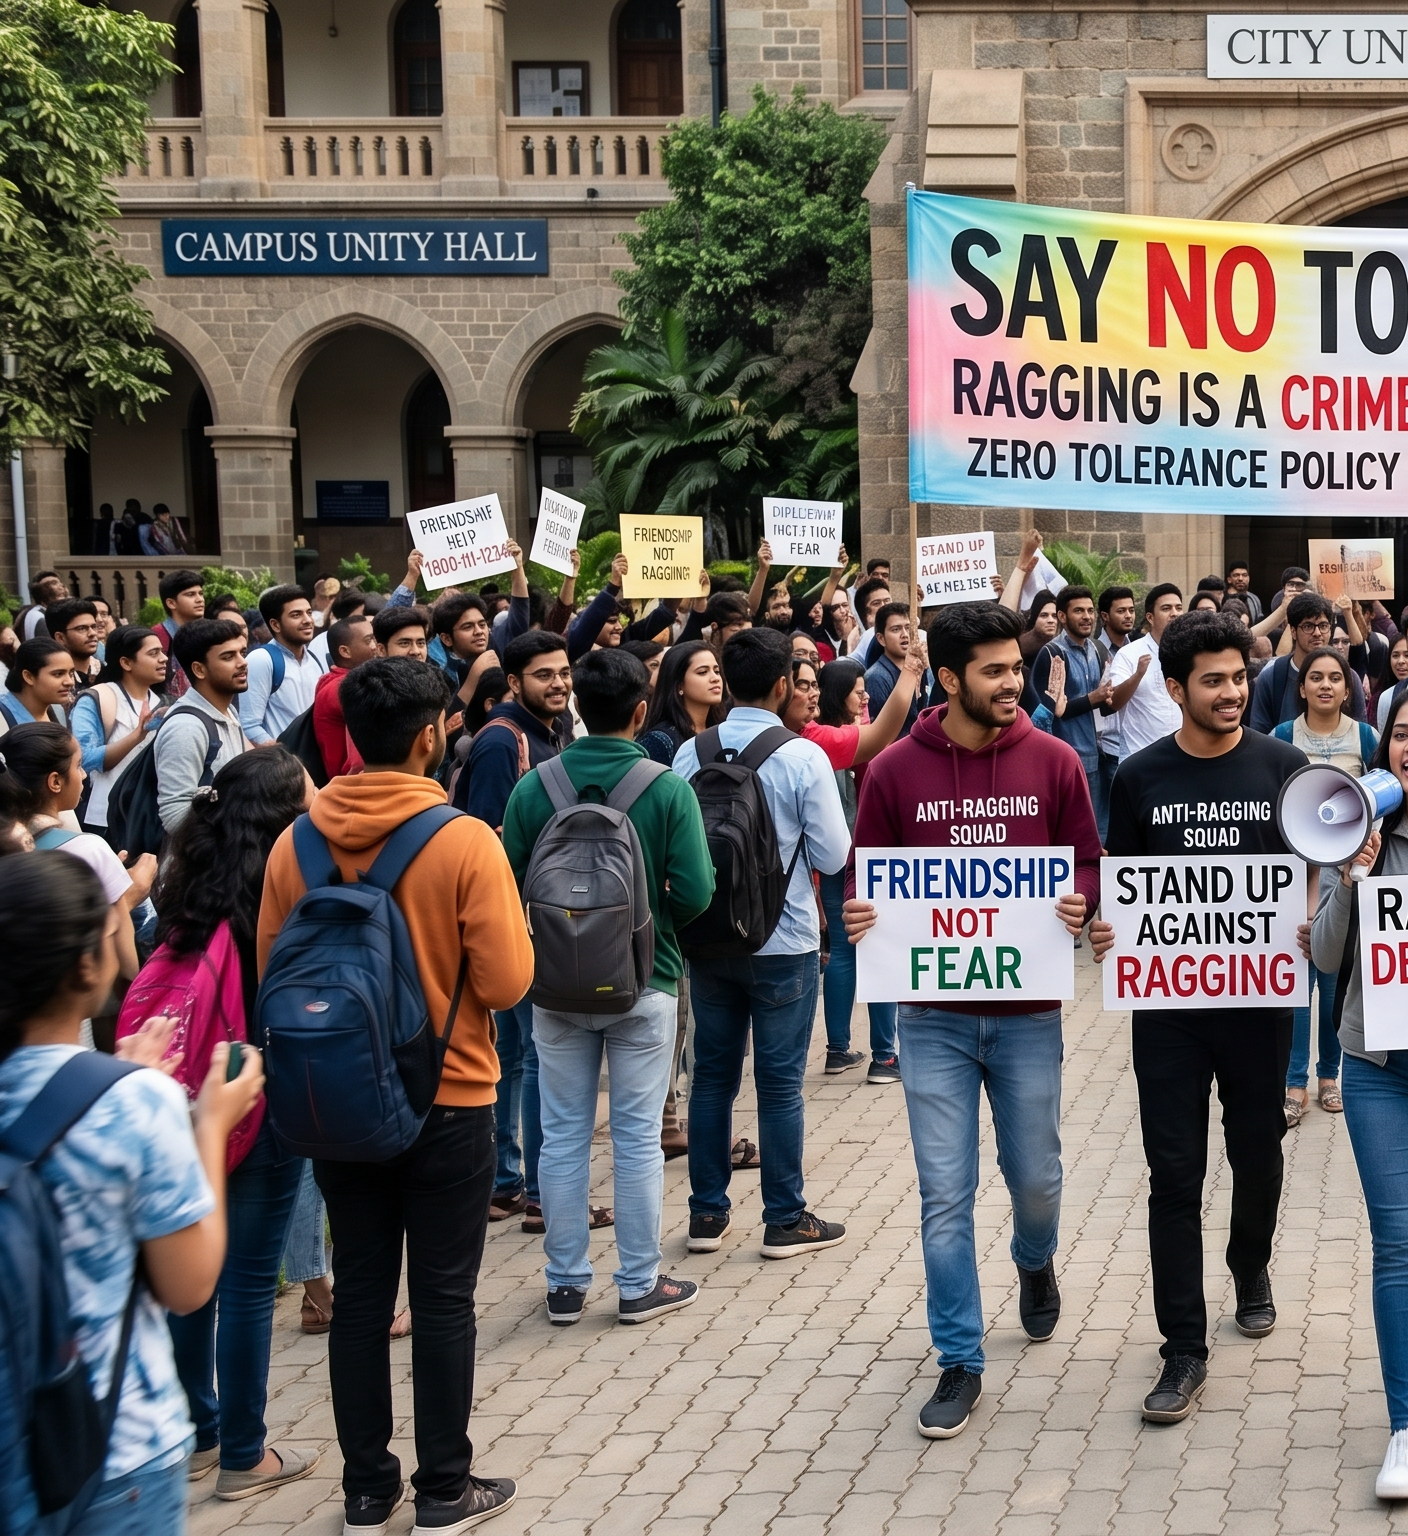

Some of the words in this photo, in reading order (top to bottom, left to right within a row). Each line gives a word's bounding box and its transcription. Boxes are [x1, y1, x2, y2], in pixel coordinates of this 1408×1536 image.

[1228, 29, 1324, 64] CITY
[176, 232, 317, 261] CAMPUS
[327, 232, 434, 261] UNITY
[444, 232, 536, 261] HALL
[951, 228, 1118, 343] SAY
[1148, 242, 1275, 352] NO
[1304, 250, 1406, 354] TO
[954, 359, 1161, 424] RAGGING
[1180, 372, 1219, 427] IS
[1235, 375, 1266, 428] A
[968, 438, 1056, 480] ZERO
[1069, 443, 1267, 488] TOLERANCE
[1281, 451, 1400, 490] POLICY
[654, 547, 675, 560] NOT
[790, 543, 820, 555] FEAR
[921, 541, 964, 556] STAND
[969, 539, 985, 552] UP
[973, 559, 987, 570] SO
[916, 796, 1038, 822] ANTI-RAGGING
[1153, 802, 1270, 824] ANTI-RAGGING
[951, 823, 1006, 844] SQUAD
[1184, 827, 1239, 847] SQUAD
[868, 858, 1069, 899] FRIENDSHIP
[1117, 866, 1233, 905] STAND
[1246, 865, 1292, 903] UP
[933, 908, 999, 937] NOT
[1137, 912, 1276, 945] AGAINST
[911, 947, 1022, 990] FEAR
[1118, 953, 1294, 998] RAGGING
